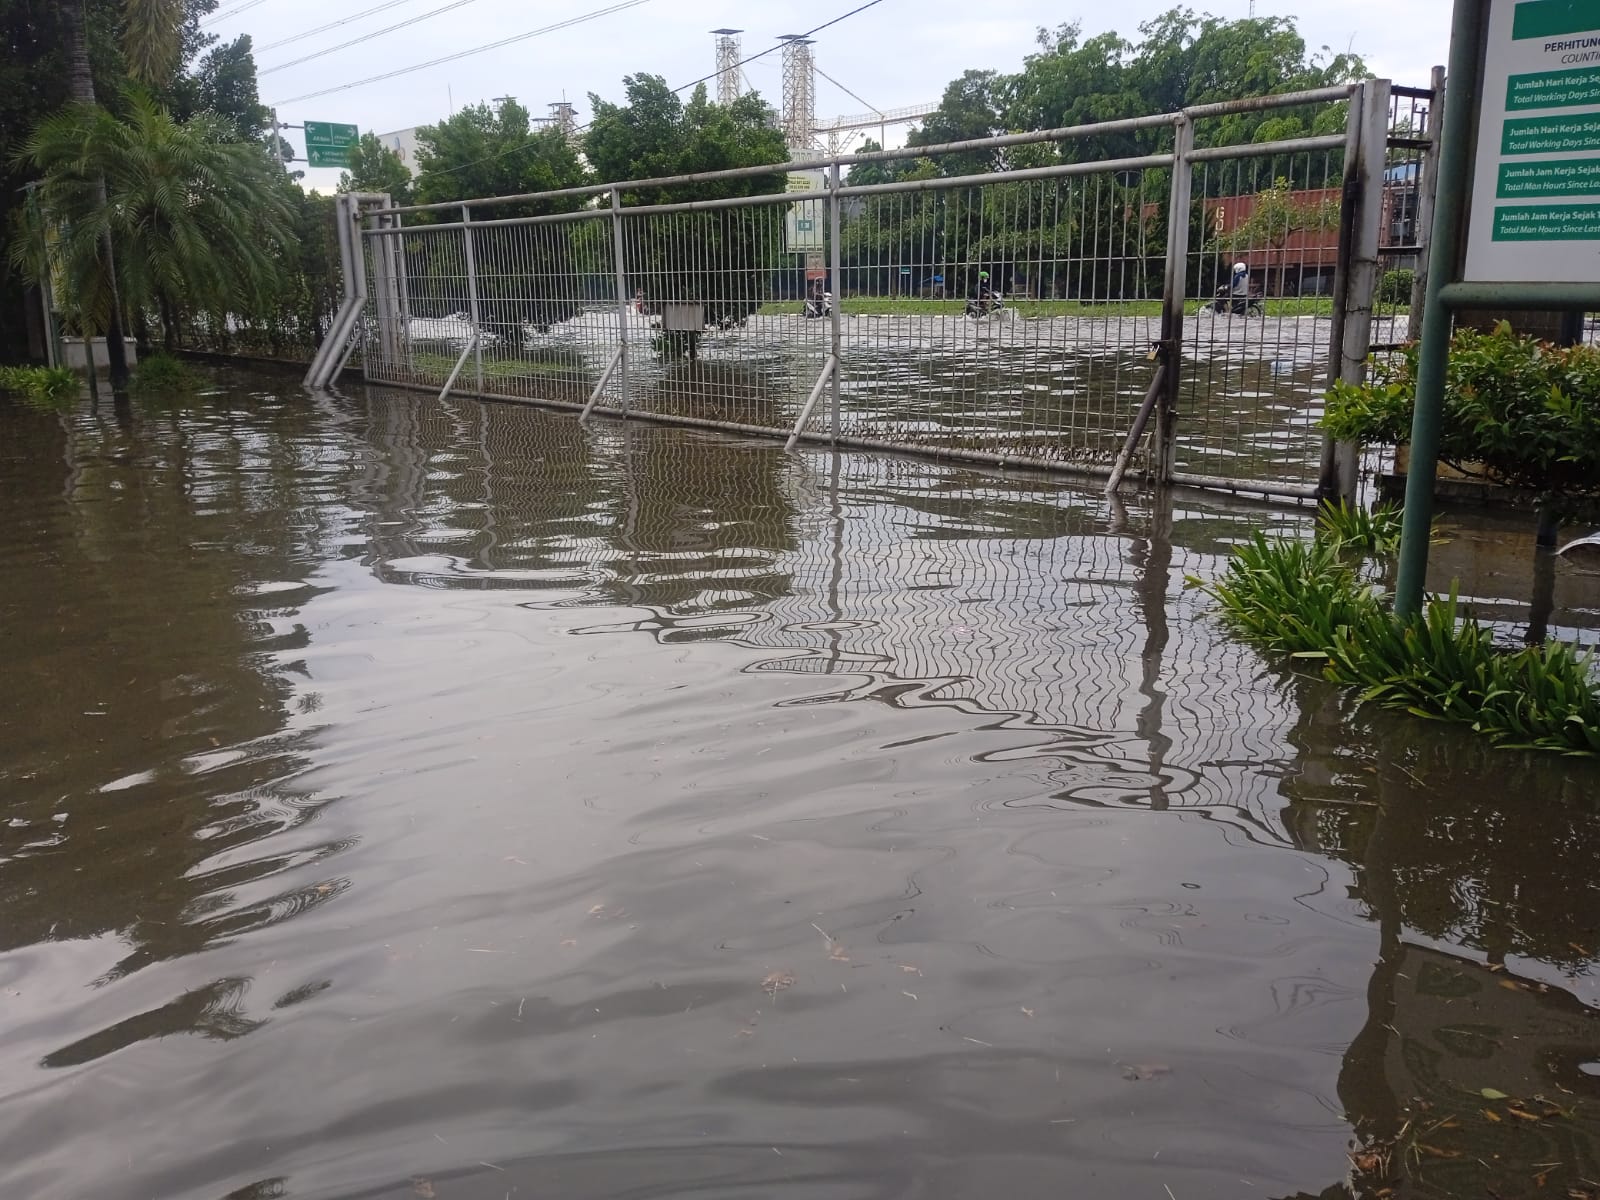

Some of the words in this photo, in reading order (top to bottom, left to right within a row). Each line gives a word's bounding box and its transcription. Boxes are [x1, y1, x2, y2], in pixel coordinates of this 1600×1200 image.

[1544, 37, 1600, 52] PERHITUN
[1561, 51, 1600, 64] COUNTI
[1514, 80, 1544, 90] Jumlah
[1546, 78, 1564, 87] Hari
[1565, 76, 1588, 86] Kerja
[1514, 94, 1533, 104] Total
[1534, 92, 1567, 102] Working
[1568, 91, 1588, 100] Days
[1510, 126, 1540, 136] Jumlah
[1540, 125, 1558, 134] Hari
[1559, 123, 1582, 133] Kerja
[1509, 141, 1528, 150] Total
[1529, 140, 1562, 149] Working
[1562, 139, 1582, 148] Days
[1505, 168, 1535, 178] Jumlah
[1535, 168, 1553, 177] Jam
[1554, 166, 1576, 177] Kerja
[1504, 183, 1524, 191] Total
[1523, 182, 1541, 191] Man
[1542, 182, 1566, 190] Hours
[1566, 180, 1589, 189] Since
[1501, 212, 1530, 222] Jumlah
[1531, 212, 1548, 221] Jam
[1549, 211, 1571, 221] Kerja
[1572, 210, 1596, 221] Sejak
[1500, 226, 1519, 234] Total
[1519, 226, 1537, 234] Man
[1538, 225, 1561, 233] Hours
[1561, 224, 1584, 233] Since
